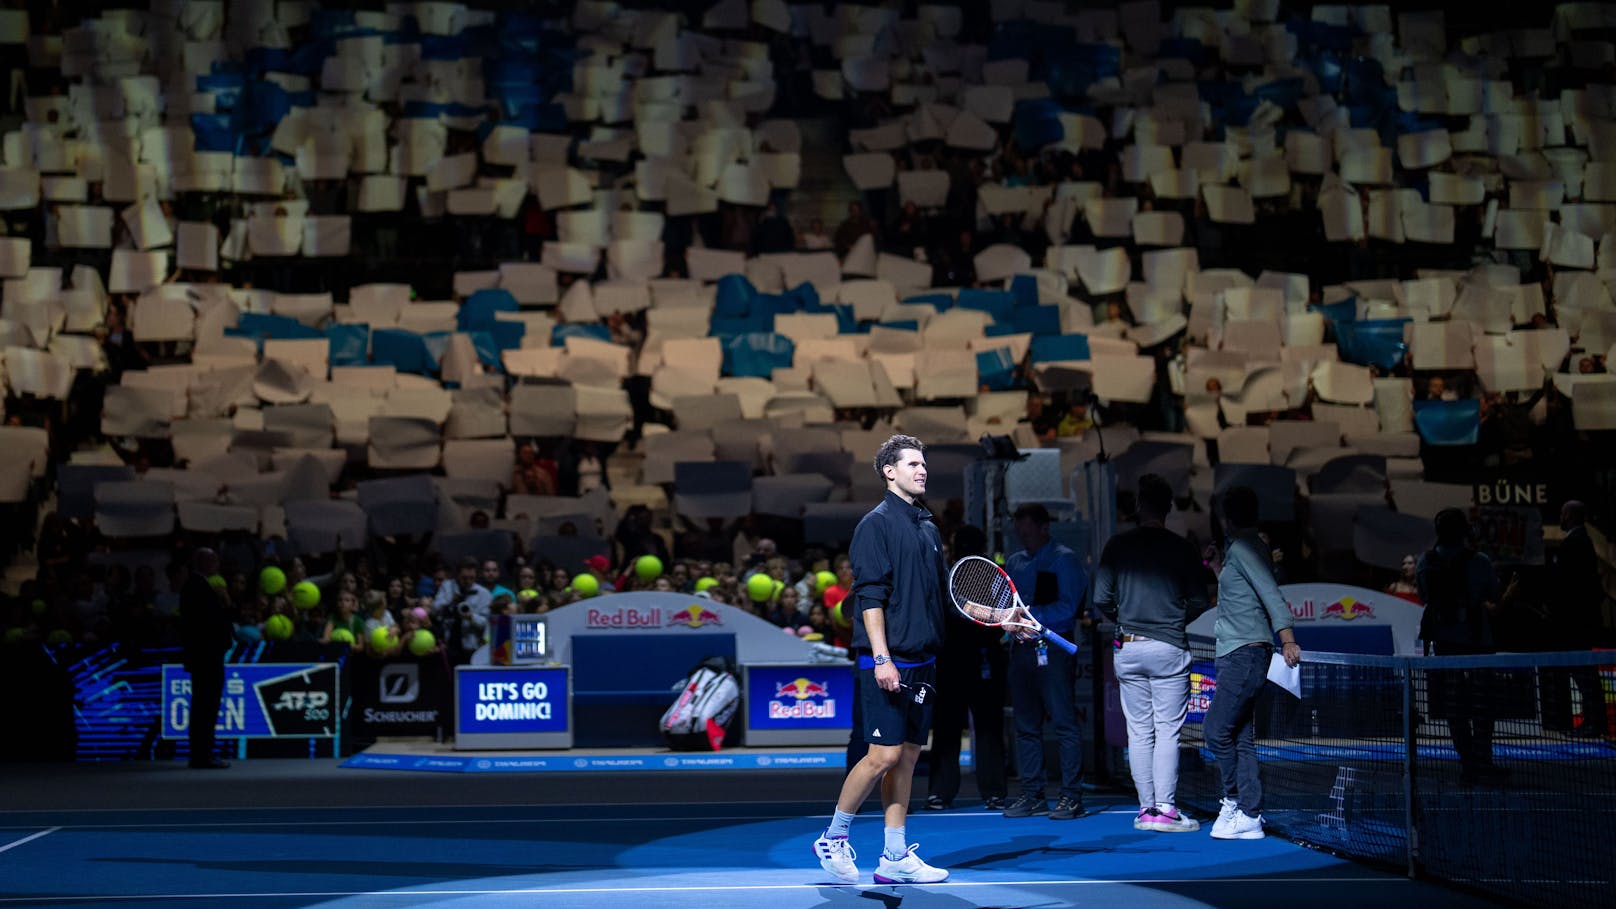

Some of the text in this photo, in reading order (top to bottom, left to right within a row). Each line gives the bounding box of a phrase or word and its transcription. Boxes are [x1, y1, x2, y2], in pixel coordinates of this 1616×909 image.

[587, 608, 660, 625] Red Bull
[272, 691, 329, 711] ATP
[478, 682, 547, 701] LET'S GO
[475, 702, 551, 721] DOMINIC!
[769, 699, 836, 719] Red Bull
